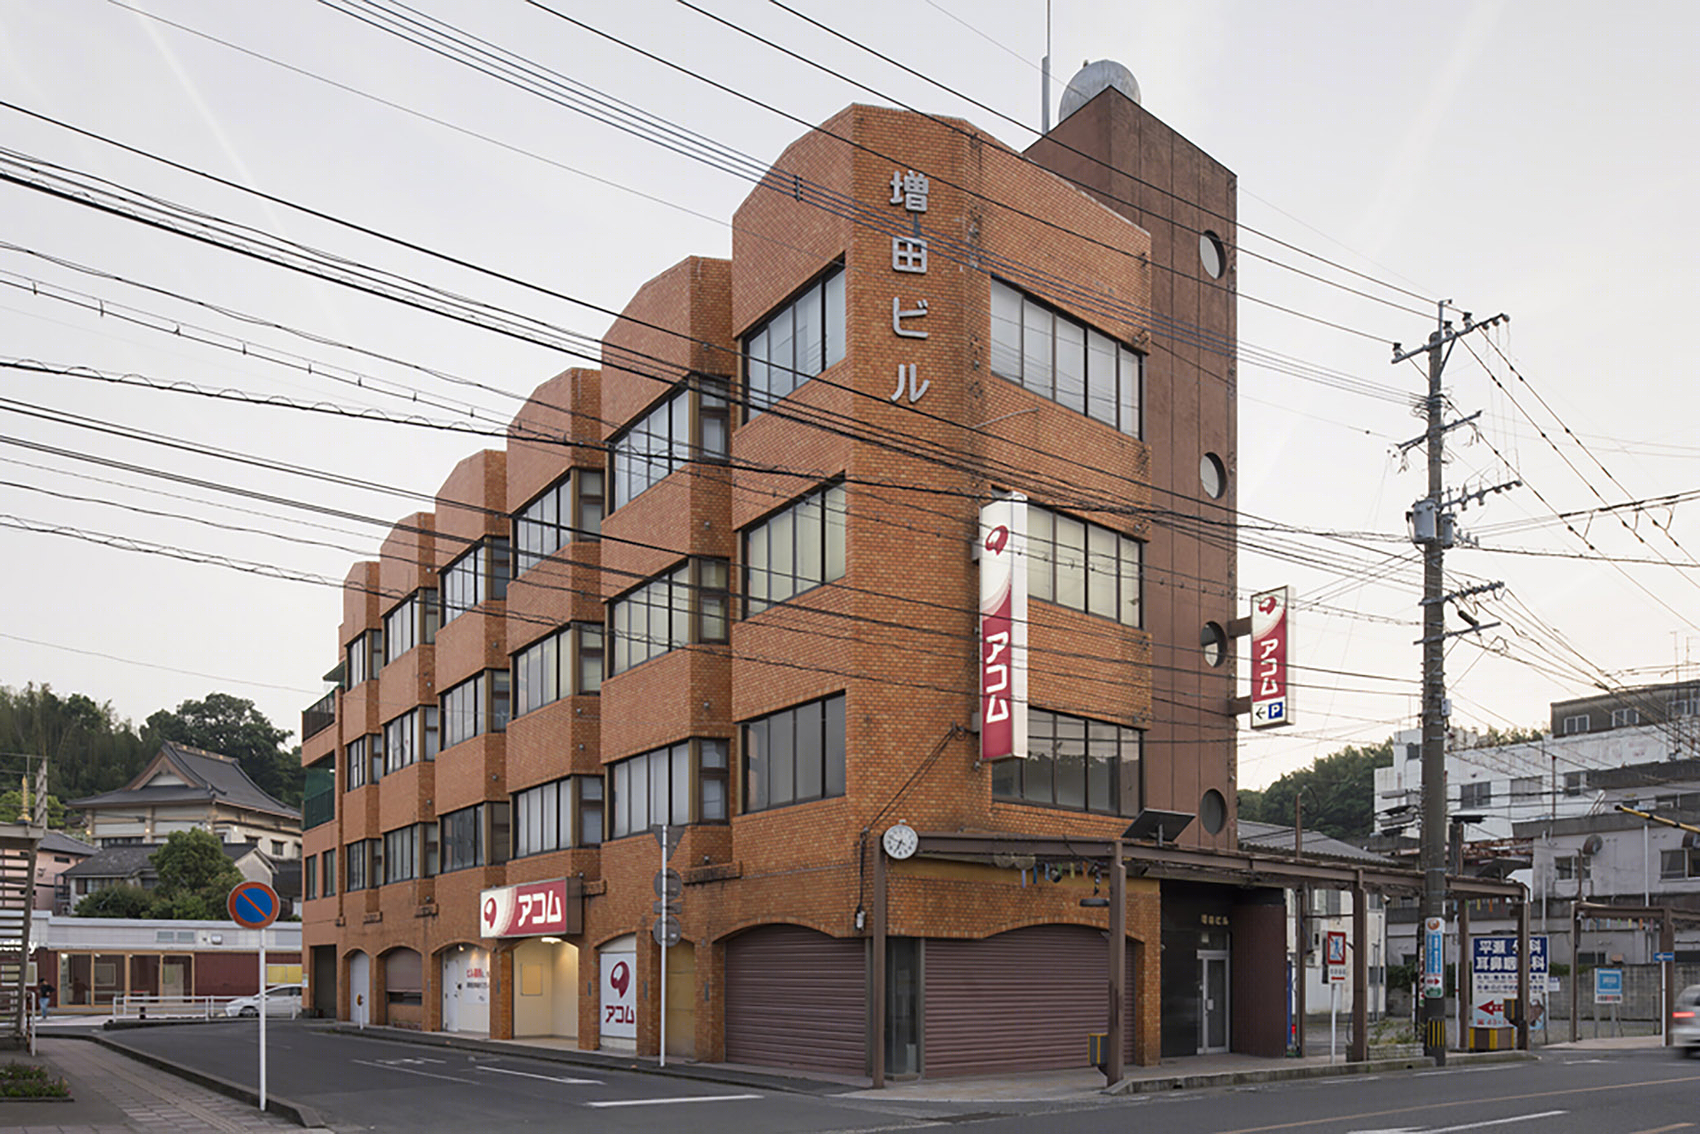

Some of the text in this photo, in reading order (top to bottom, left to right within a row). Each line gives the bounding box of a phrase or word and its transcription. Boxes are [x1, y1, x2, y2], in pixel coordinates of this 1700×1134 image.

[889, 170, 930, 403] 増田ビル
[986, 631, 1009, 723] アコム
[1260, 638, 1279, 696] アコム
[517, 890, 562, 927] アコム
[605, 1005, 635, 1024] アコム
